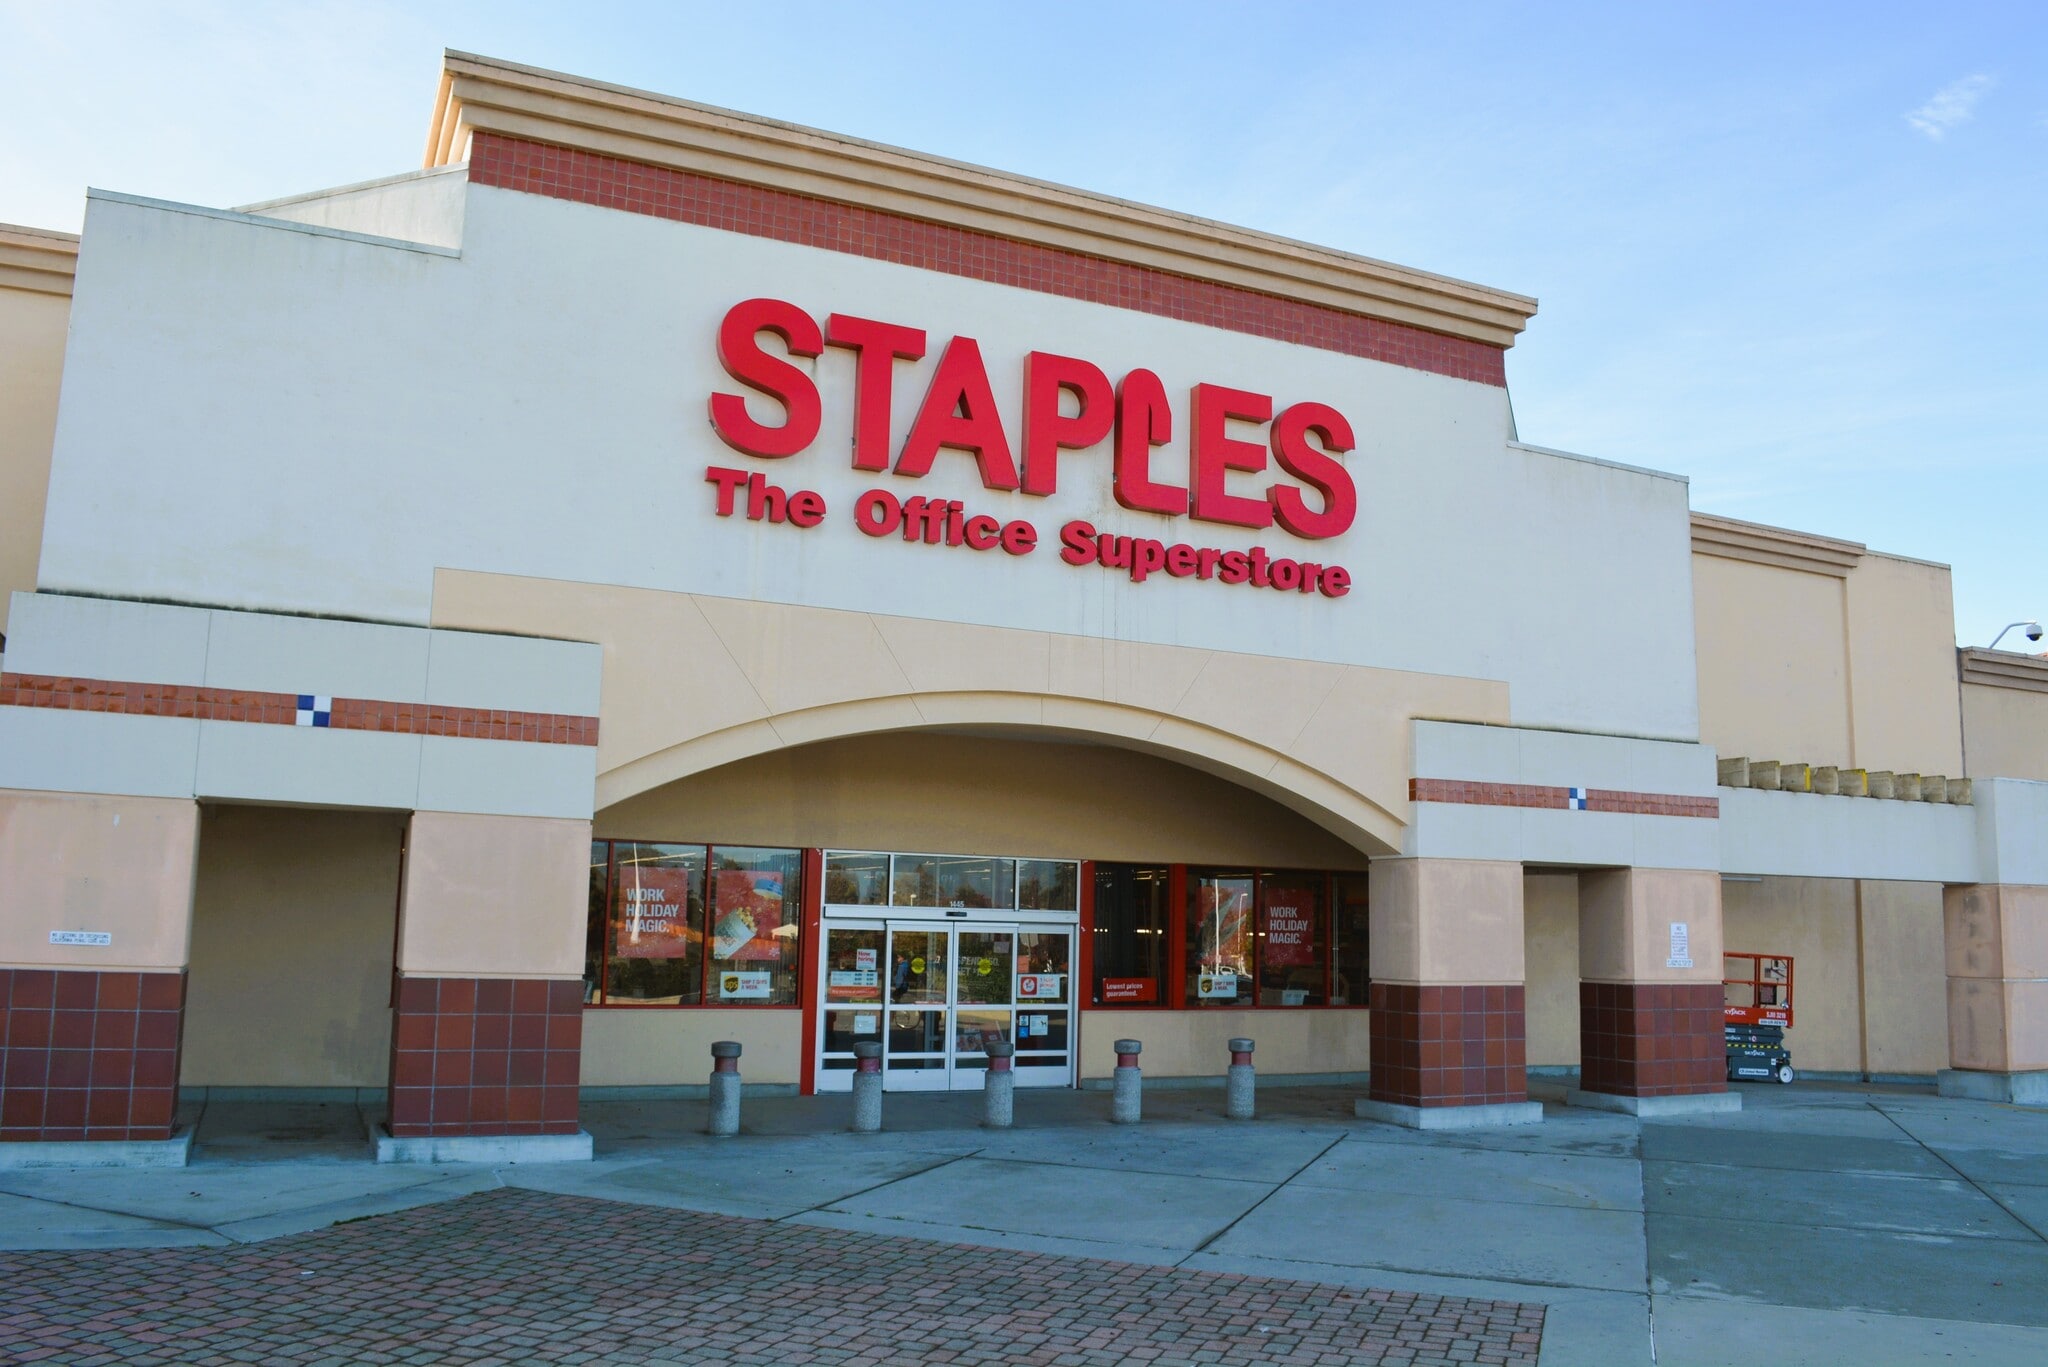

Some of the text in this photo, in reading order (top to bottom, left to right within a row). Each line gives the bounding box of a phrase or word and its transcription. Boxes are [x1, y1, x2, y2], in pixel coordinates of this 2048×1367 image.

[708, 298, 1356, 540] STAPLES
[705, 466, 1351, 597] The Office Superstore
[626, 888, 665, 901] WORK
[626, 903, 679, 917] HOLIDAY
[1269, 906, 1298, 918] WORK
[625, 919, 669, 933] MAGIC.
[1270, 919, 1308, 931] HOLIDAY
[1269, 932, 1301, 944] MAGIC.
[1126, 983, 1143, 991] prices
[1106, 990, 1138, 998] guaranteed.
